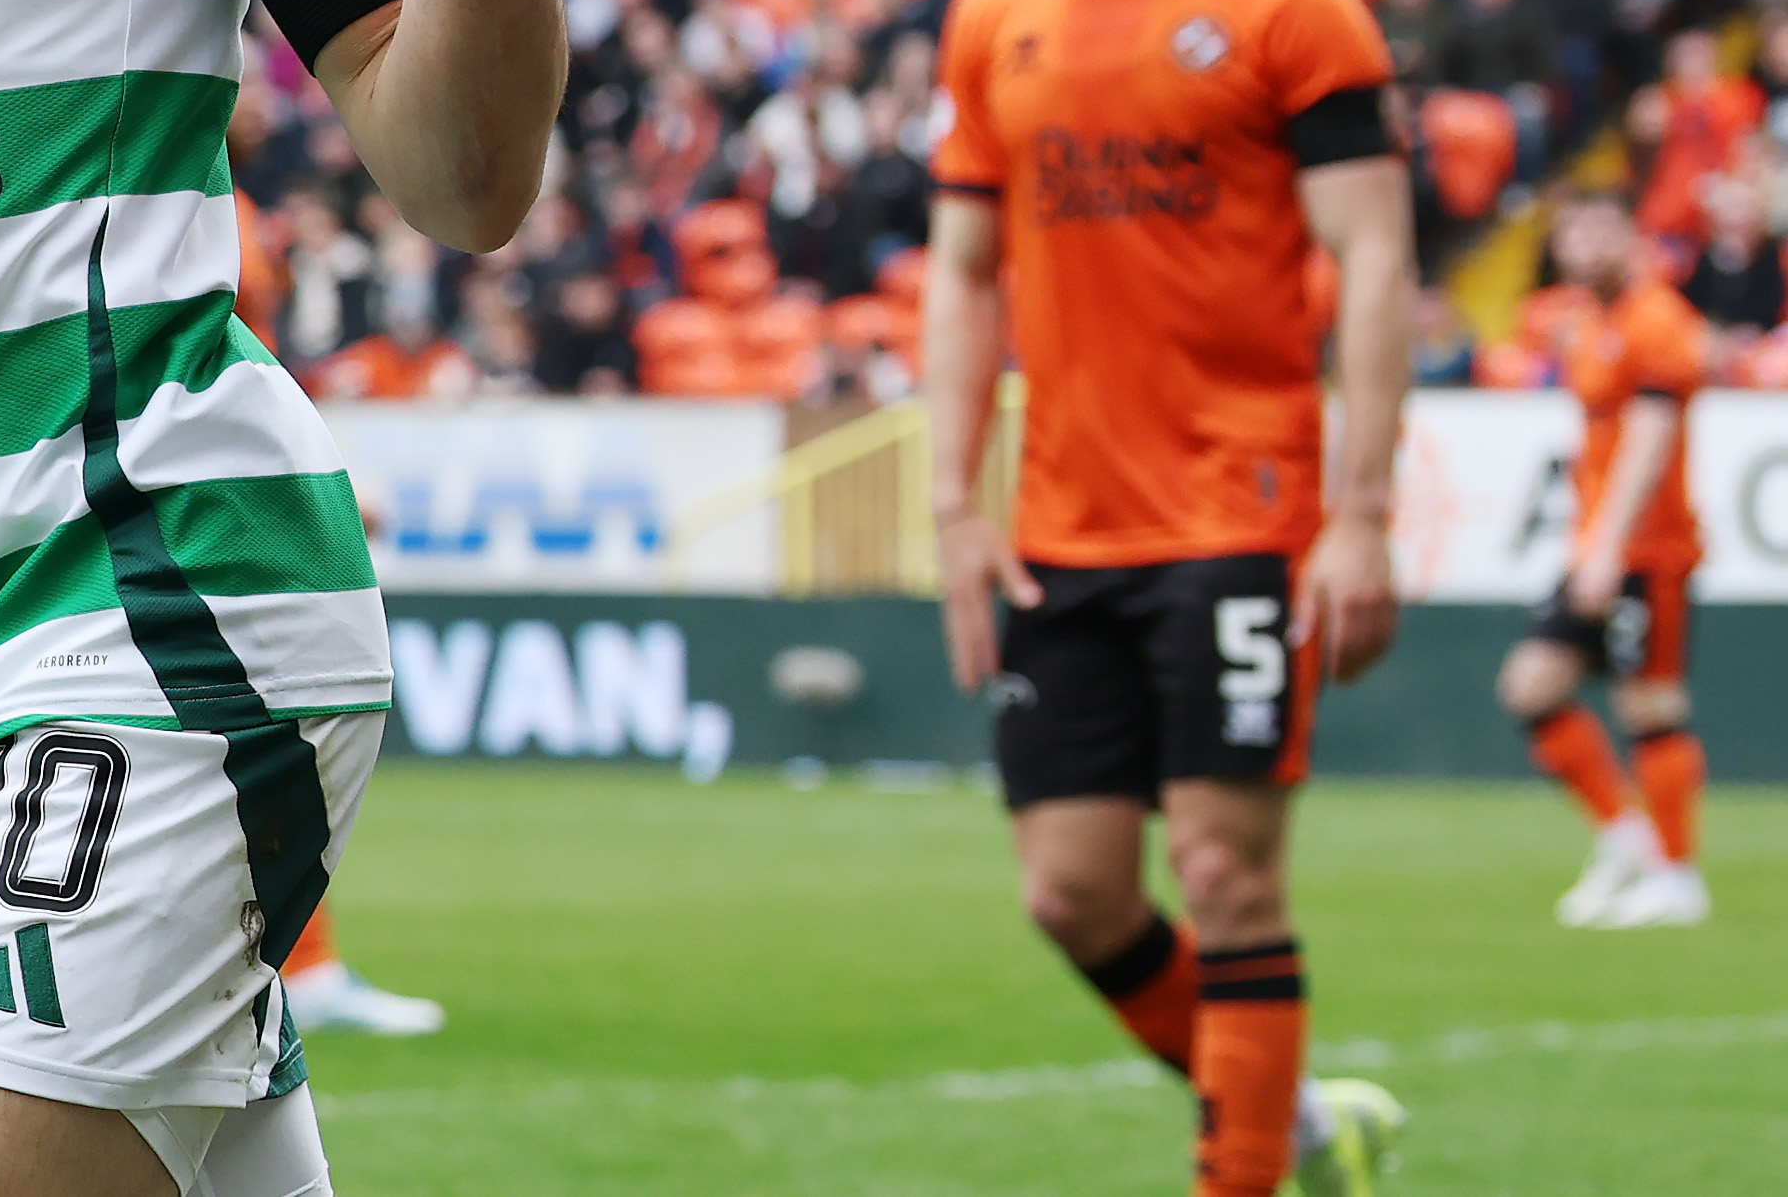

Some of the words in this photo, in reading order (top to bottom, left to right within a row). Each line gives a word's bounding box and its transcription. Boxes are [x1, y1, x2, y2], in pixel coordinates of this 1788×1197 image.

[36, 654, 108, 669] AEROREADY
[389, 618, 734, 785] VAN,
[1216, 596, 1287, 702] 5
